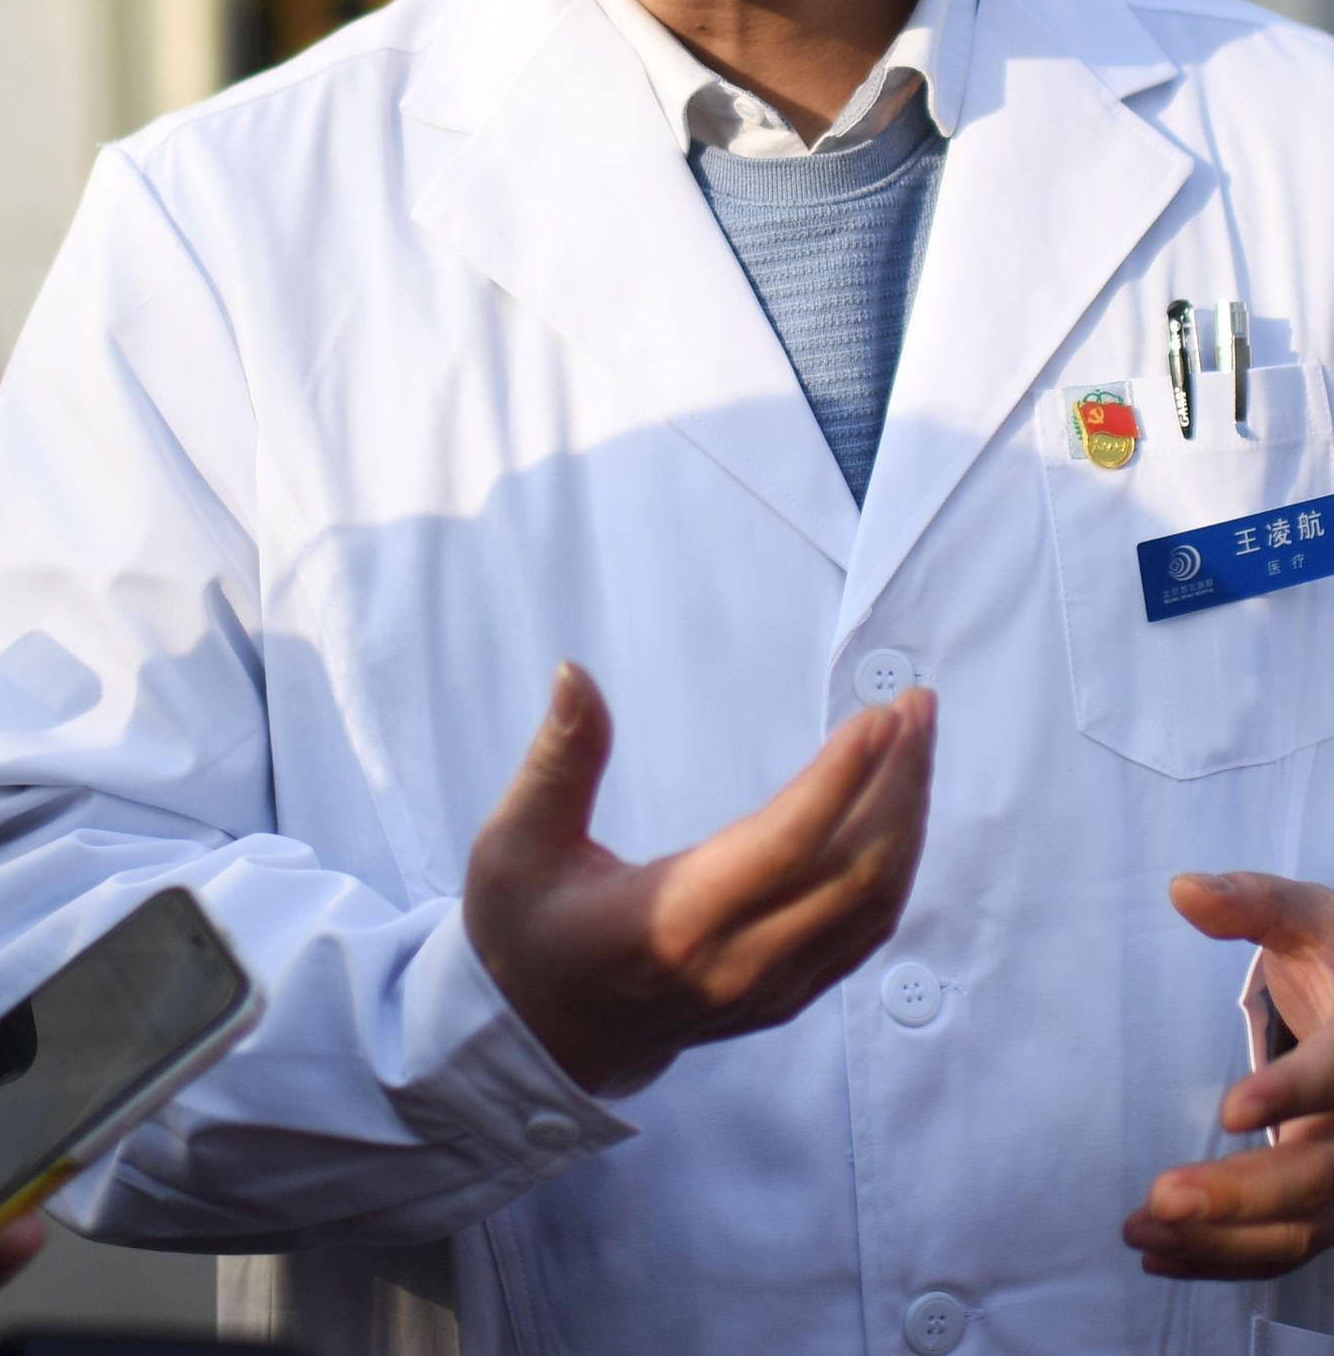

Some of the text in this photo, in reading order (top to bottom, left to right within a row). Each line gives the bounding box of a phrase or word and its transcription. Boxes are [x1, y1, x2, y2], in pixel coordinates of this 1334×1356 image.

[1234, 510, 1326, 556] 王凌航
[1267, 553, 1306, 576] 医疗
